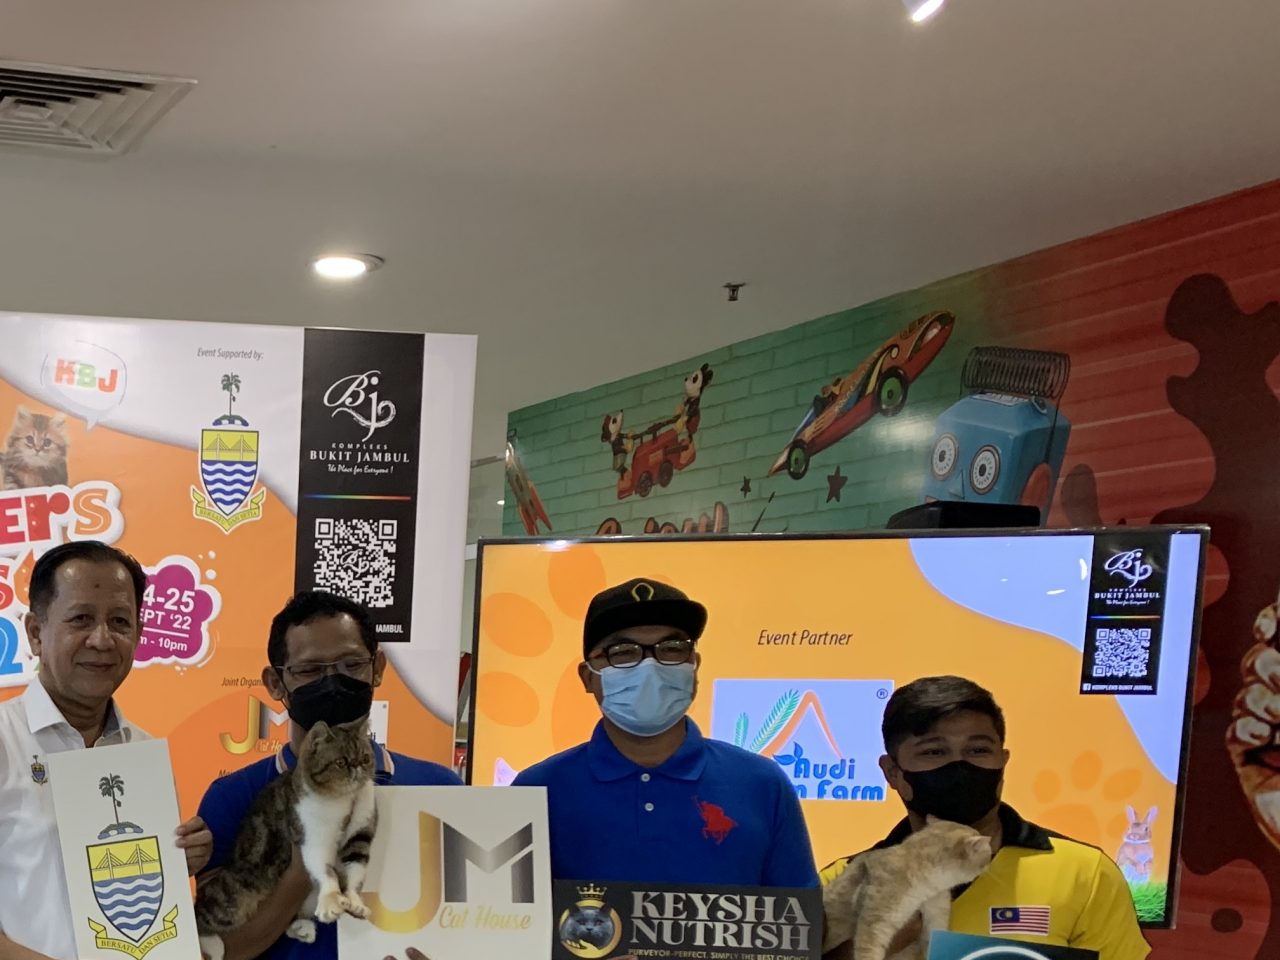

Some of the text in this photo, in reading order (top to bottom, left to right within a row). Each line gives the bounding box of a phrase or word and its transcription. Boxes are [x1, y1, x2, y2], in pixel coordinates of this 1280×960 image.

[197, 347, 217, 357] Event
[217, 347, 253, 360] Supported
[55, 358, 118, 392] KBJ
[310, 450, 410, 463] BUKIT JAMBUL
[143, 584, 196, 613] 4-25
[158, 637, 188, 651] 10pm
[758, 629, 853, 646] Event Partner
[221, 677, 240, 687] Joint
[816, 779, 884, 801] Farm
[439, 904, 532, 931] Cat House
[631, 890, 811, 925] KEYSHA
[101, 930, 174, 955] BERSATU DAN SETIA
[629, 918, 811, 951] NUTRISH
[741, 953, 755, 960] THE
